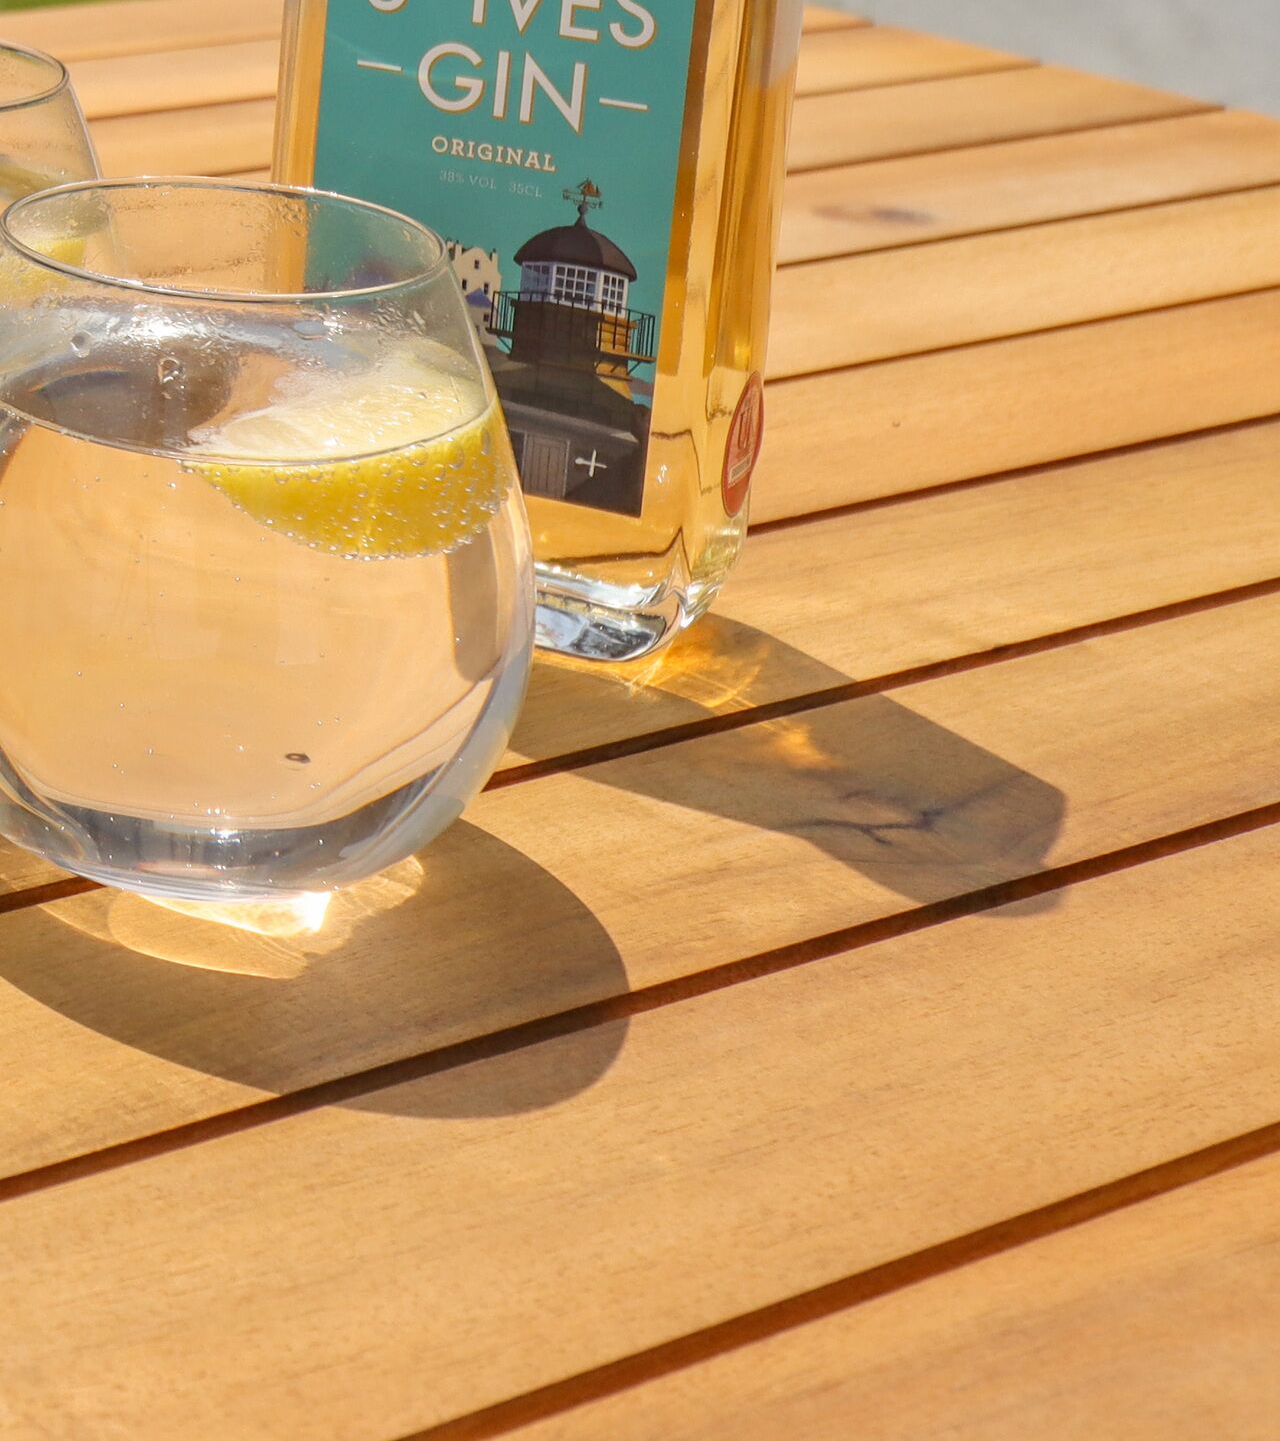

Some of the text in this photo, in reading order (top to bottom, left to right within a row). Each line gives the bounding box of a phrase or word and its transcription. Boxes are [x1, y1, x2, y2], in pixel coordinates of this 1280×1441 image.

[417, 42, 588, 135] GIN
[431, 136, 557, 173] ORIGINAL
[469, 175, 497, 190] VOL
[509, 181, 542, 198] 35CL
